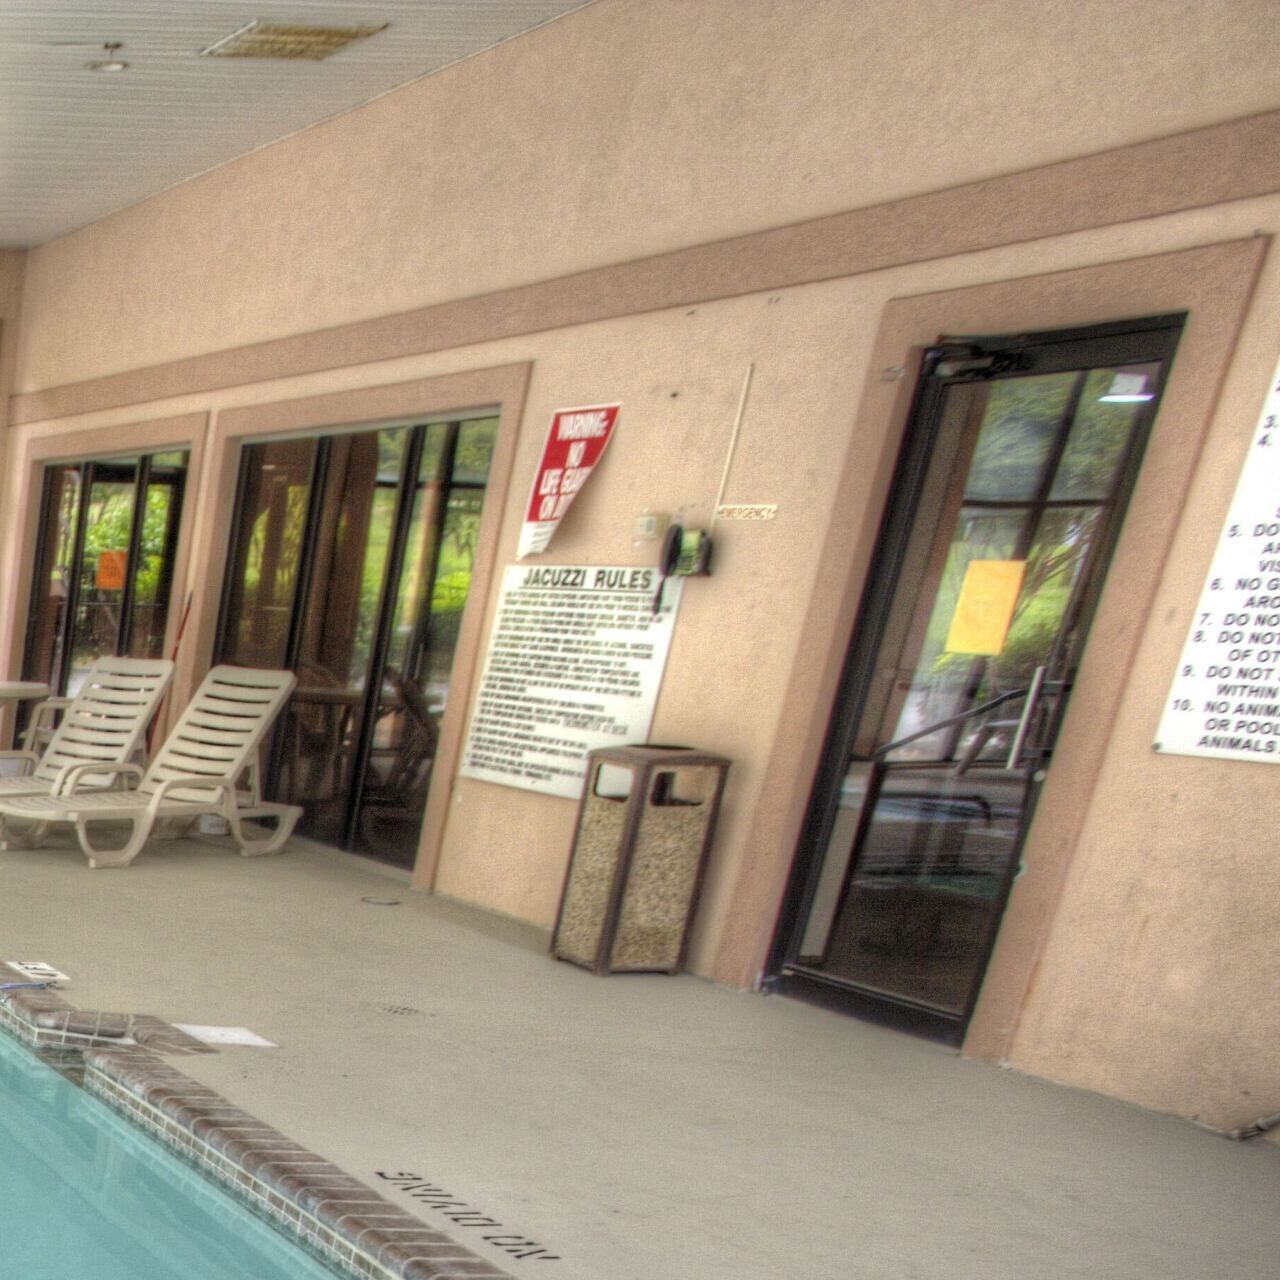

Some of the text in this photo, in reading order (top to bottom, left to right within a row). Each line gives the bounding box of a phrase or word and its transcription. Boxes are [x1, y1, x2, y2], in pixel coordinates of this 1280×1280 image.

[1228, 523, 1280, 537] 5. DO
[523, 568, 653, 589] JACUZZI RULES
[1210, 578, 1225, 591] 6.
[1235, 578, 1262, 591] NO
[1200, 612, 1213, 626] 7.
[1223, 613, 1250, 626] DO
[1193, 630, 1207, 643] 8.
[1217, 631, 1244, 644] DO
[1227, 649, 1253, 662] OF
[1182, 664, 1275, 681] 9. DO NOT
[1217, 684, 1279, 699] WITHIN
[1172, 698, 1280, 718] 10. NO ANIM
[1204, 718, 1231, 731] OR
[1196, 735, 1276, 753] ANIMALS
[375, 1171, 561, 1261] NO DIVING
